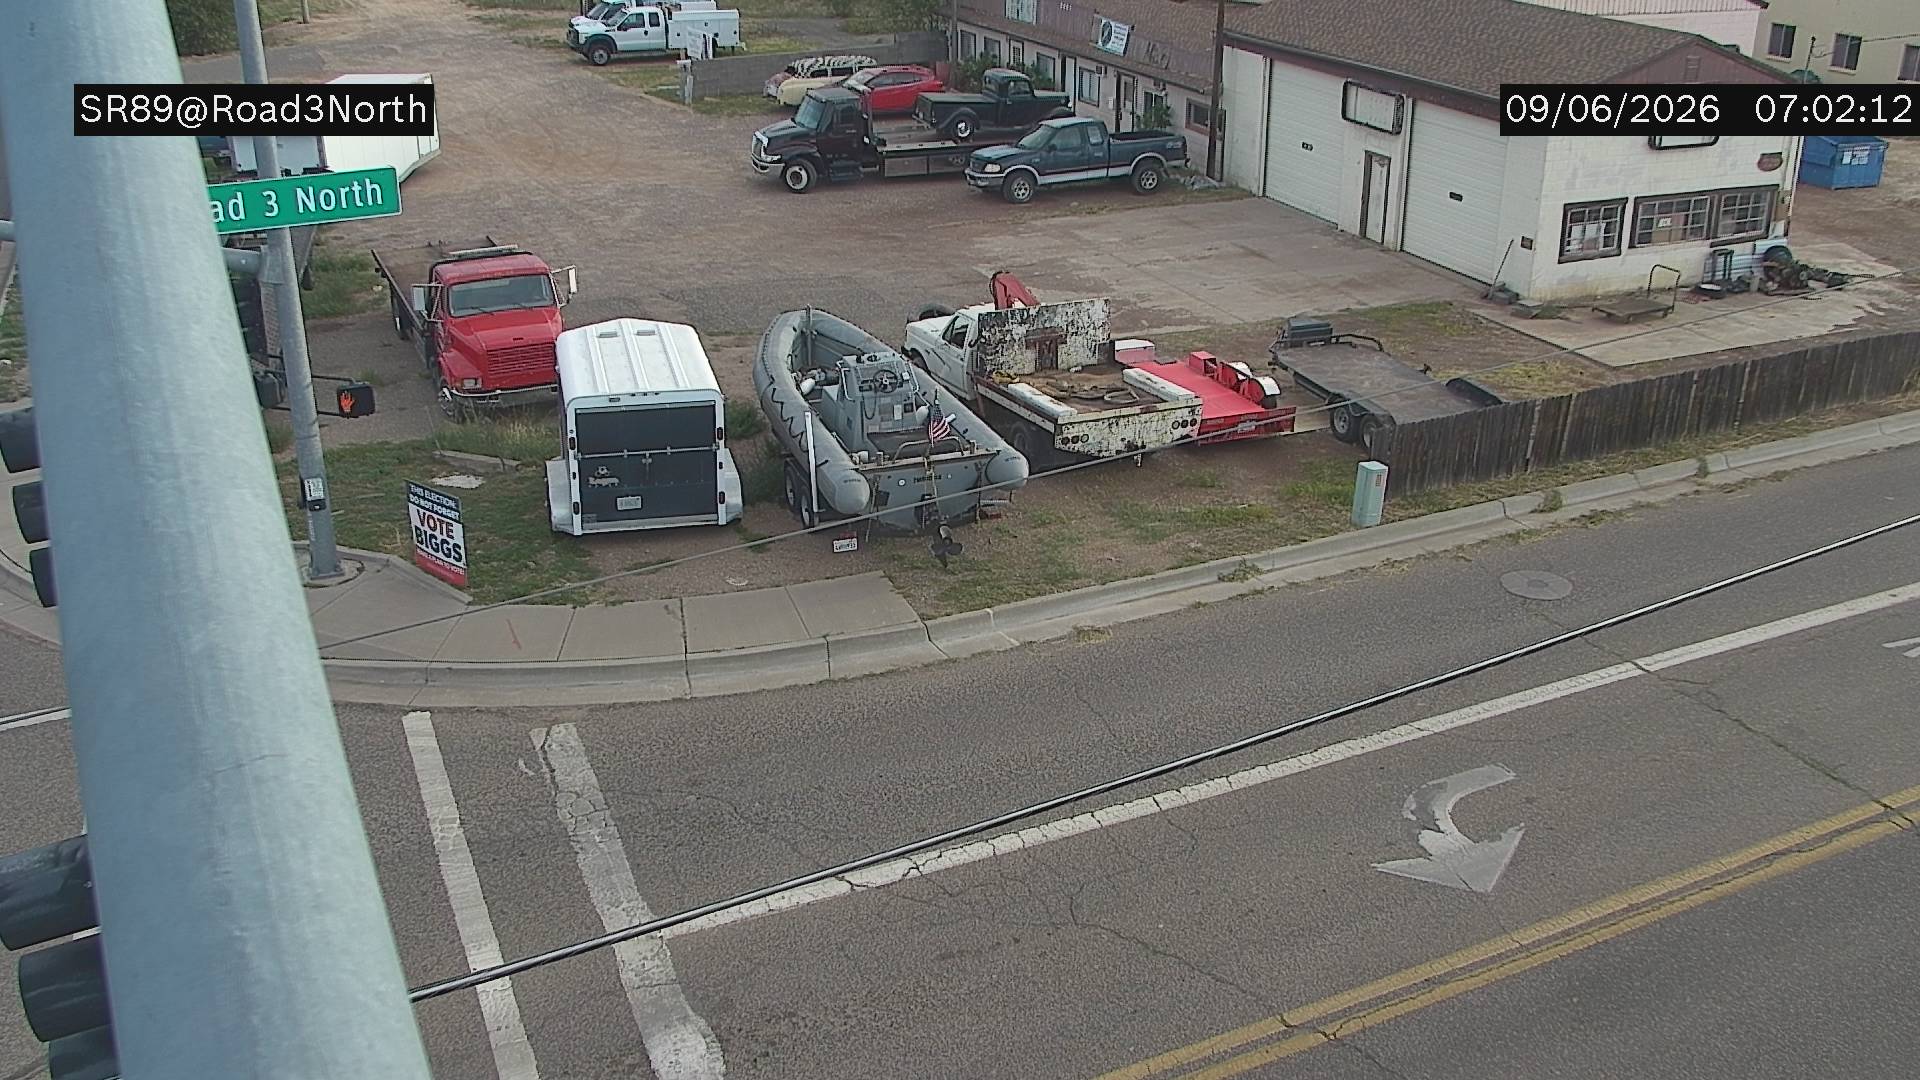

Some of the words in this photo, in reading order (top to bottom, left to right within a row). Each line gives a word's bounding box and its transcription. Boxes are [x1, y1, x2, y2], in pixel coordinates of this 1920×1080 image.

[210, 191, 246, 223] ad
[262, 190, 280, 217] 3
[295, 178, 383, 214] North
[409, 483, 424, 497] THIS
[409, 493, 420, 505] DO
[420, 498, 433, 511] NOT
[433, 503, 460, 521] FORGET
[416, 508, 455, 540] VOTE
[414, 524, 463, 562] BIGGS
